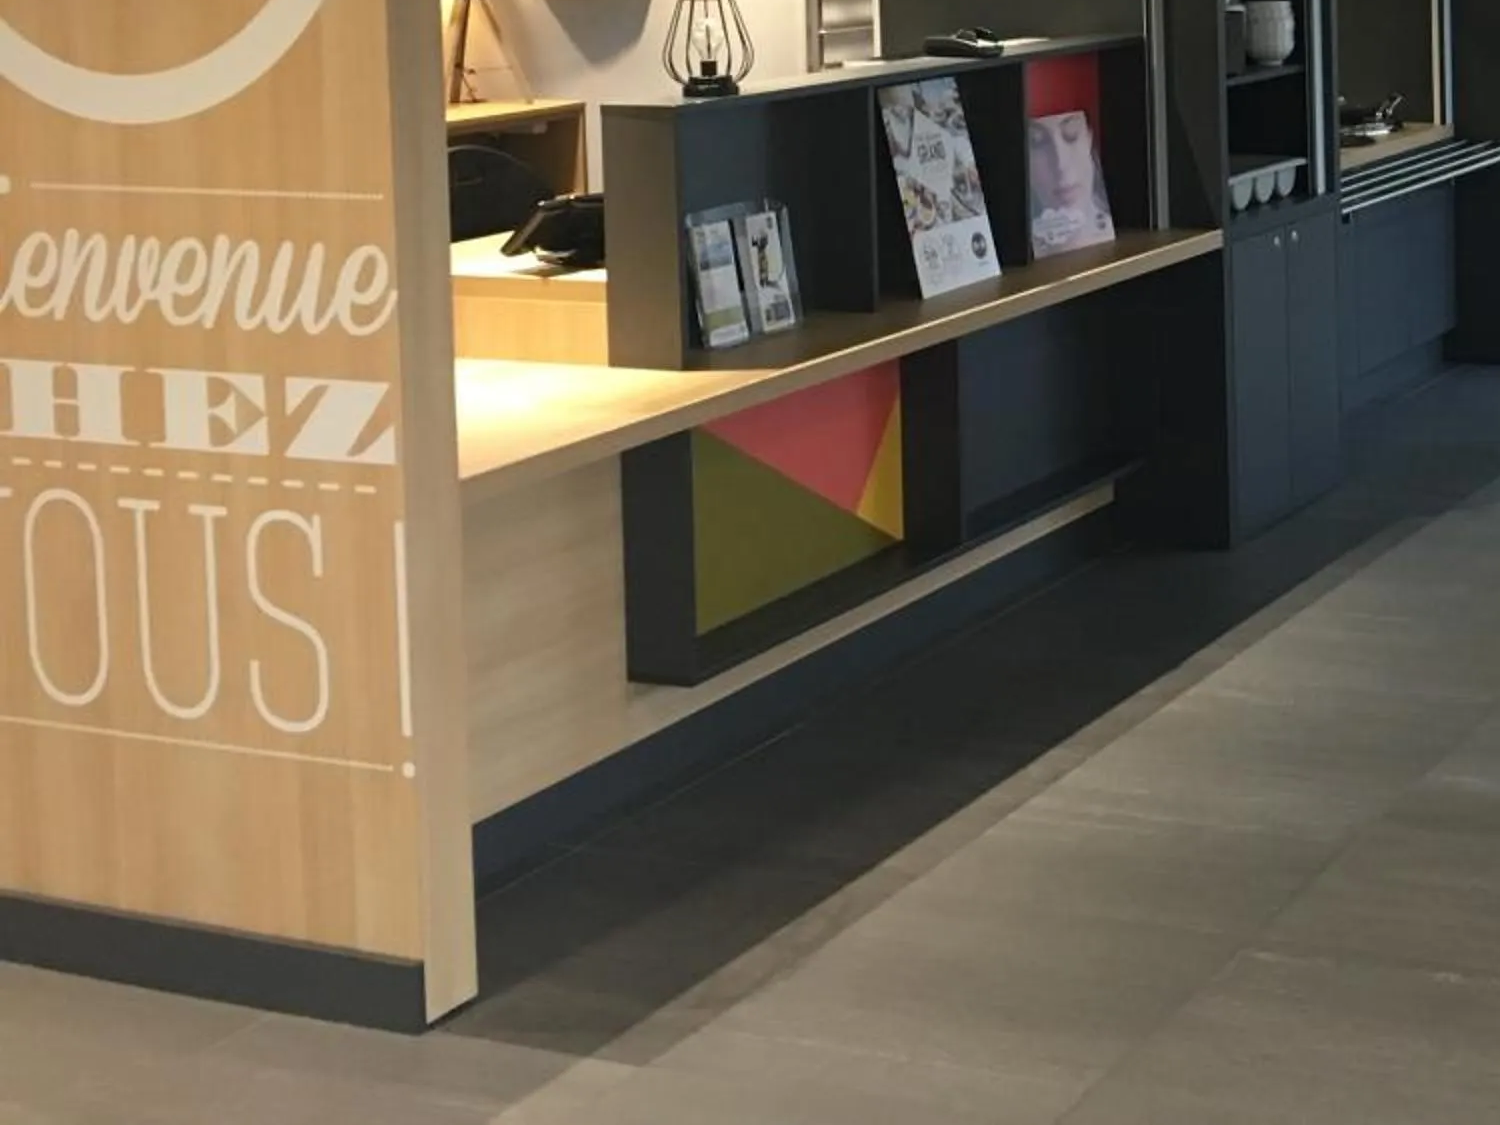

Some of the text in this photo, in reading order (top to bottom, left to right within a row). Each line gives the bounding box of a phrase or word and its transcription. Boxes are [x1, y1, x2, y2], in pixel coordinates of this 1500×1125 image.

[0, 227, 398, 338] envenue
[0, 357, 398, 465] HEZ
[0, 487, 329, 734] OUS
